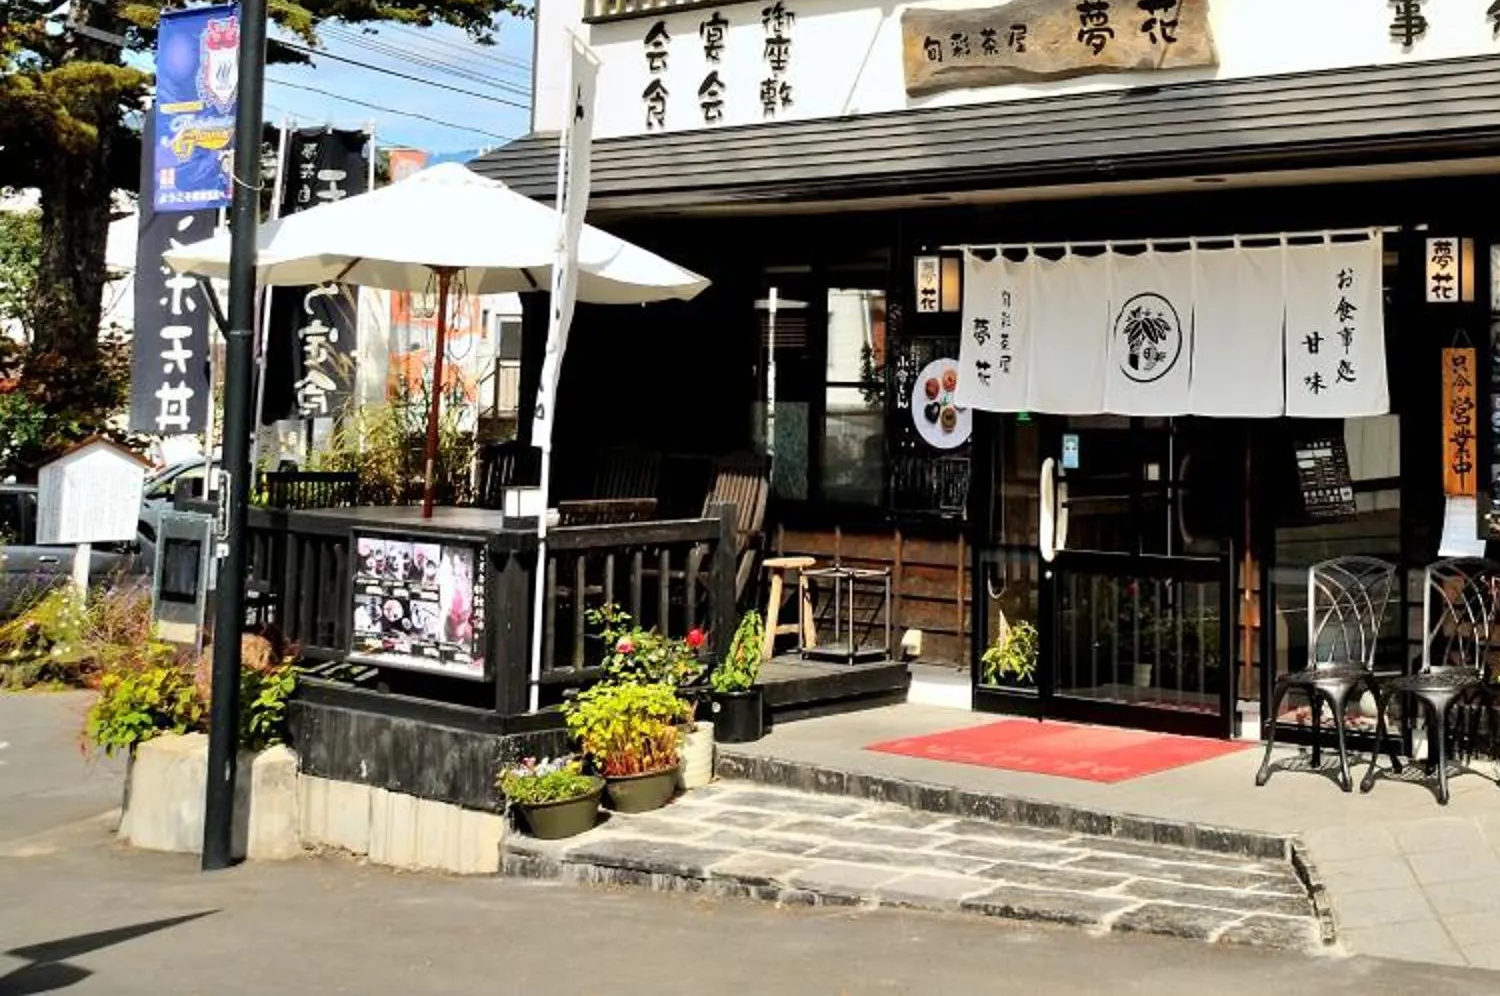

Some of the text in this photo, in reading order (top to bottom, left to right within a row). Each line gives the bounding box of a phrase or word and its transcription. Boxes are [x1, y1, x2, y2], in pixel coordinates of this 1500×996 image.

[642, 20, 670, 130] 会食
[699, 11, 729, 123] 宴会
[760, 0, 796, 117] 御座敷
[922, 22, 1028, 63] 旬彩茶屋
[1431, 240, 1453, 300] 夢花
[1302, 330, 1327, 396] 甘味
[1335, 267, 1357, 385] お食事処
